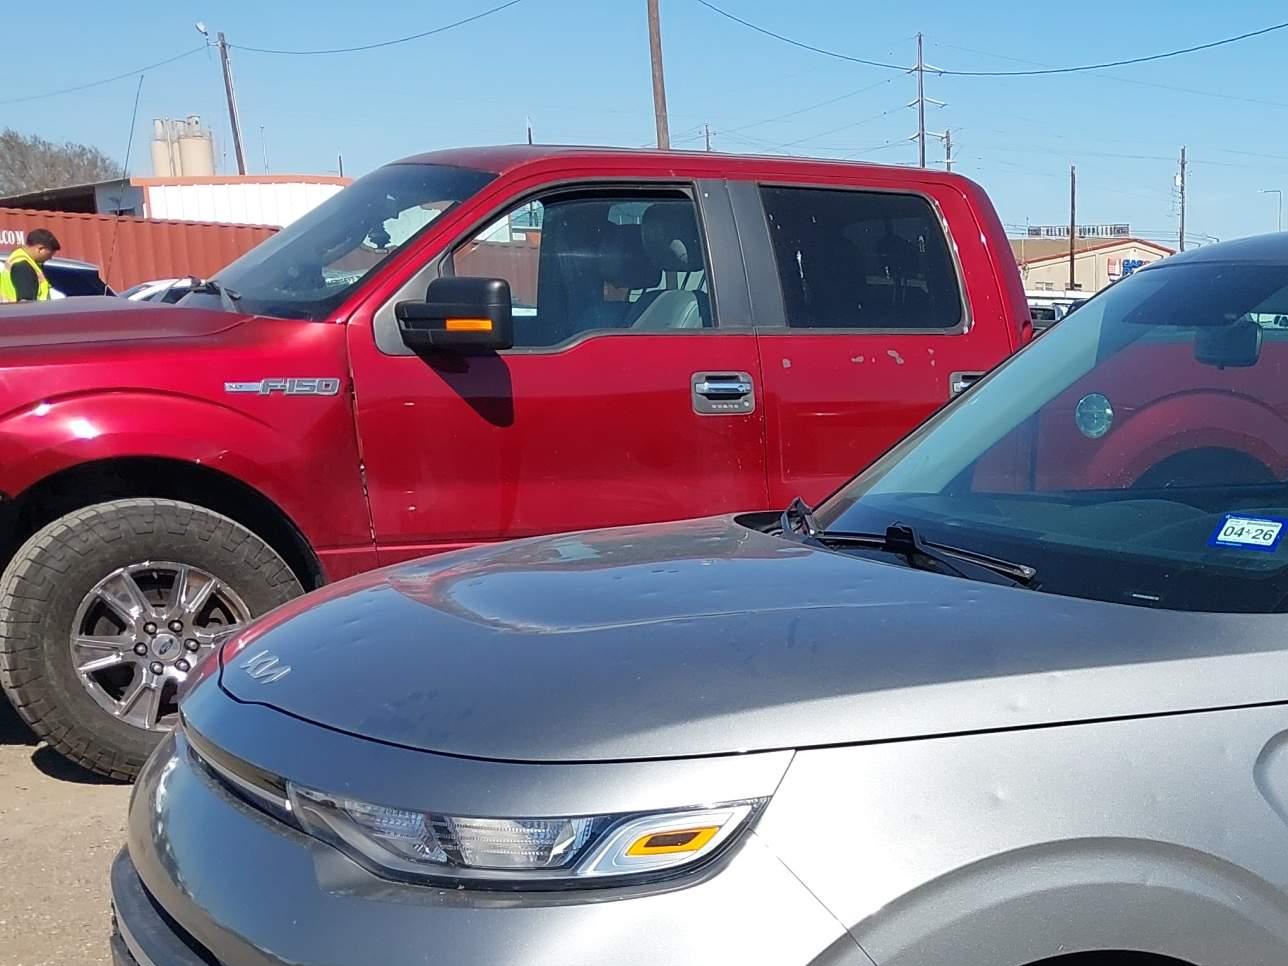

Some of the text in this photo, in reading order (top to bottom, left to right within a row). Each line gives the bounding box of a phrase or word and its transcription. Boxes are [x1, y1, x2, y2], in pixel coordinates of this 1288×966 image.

[1078, 225, 1113, 236] SUPPLIES
[260, 378, 341, 396] F-150
[1222, 525, 1275, 541] 04 26
